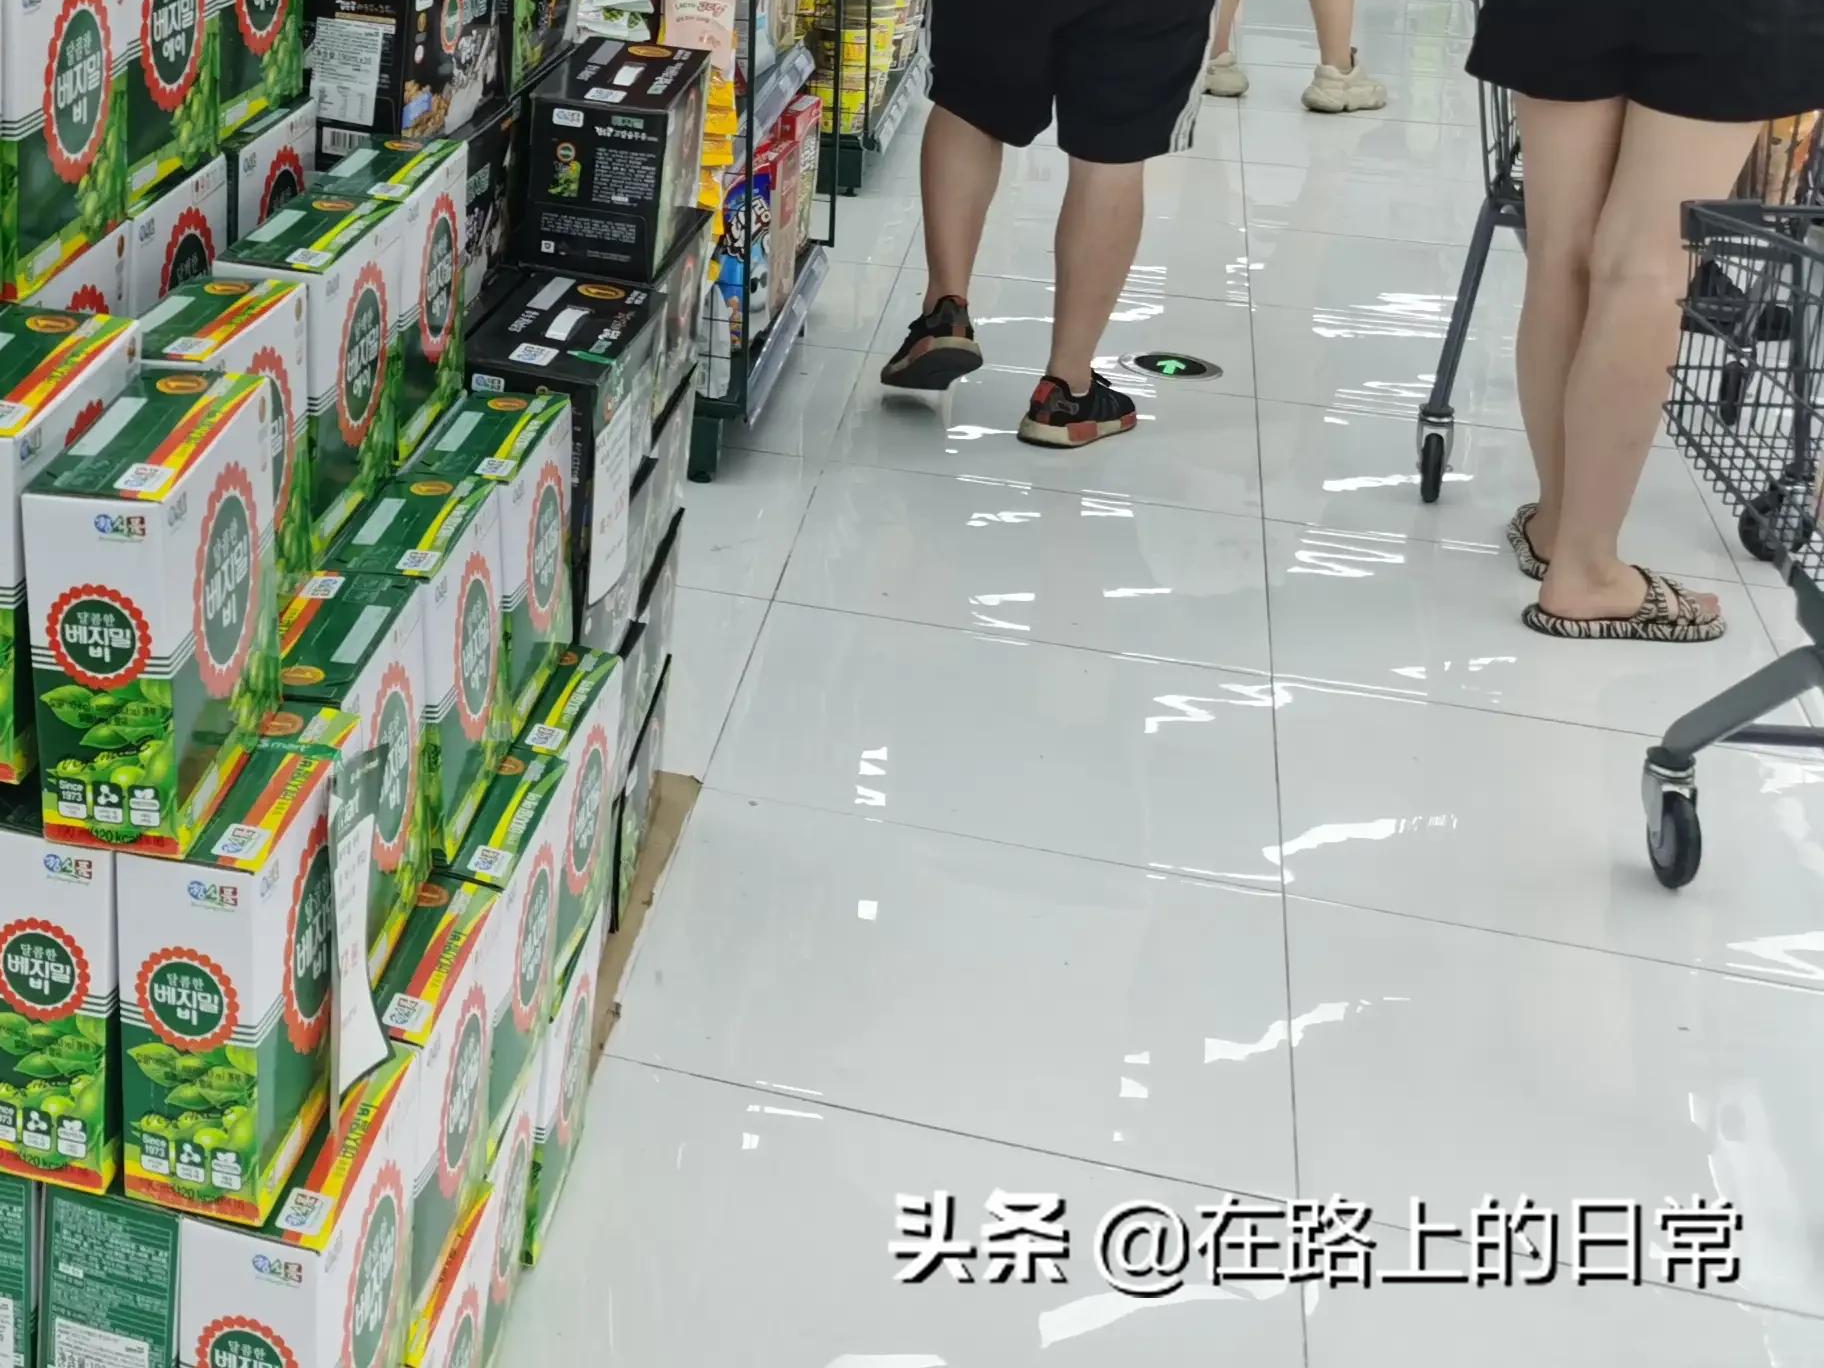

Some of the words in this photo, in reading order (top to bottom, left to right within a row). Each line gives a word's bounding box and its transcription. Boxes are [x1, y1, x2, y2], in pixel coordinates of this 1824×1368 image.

[161, 32, 187, 63] 에이
[56, 54, 102, 110] 베지밀
[72, 99, 89, 125] 비
[64, 623, 132, 650] 베지밀
[88, 644, 112, 664] 비
[58, 779, 85, 794] Since
[61, 789, 84, 804] 1973
[7, 954, 71, 985] 베지밀
[28, 977, 50, 995] 비
[153, 983, 220, 1015] 베지밀
[141, 1134, 167, 1148] Since
[143, 1144, 166, 1158] 1973
